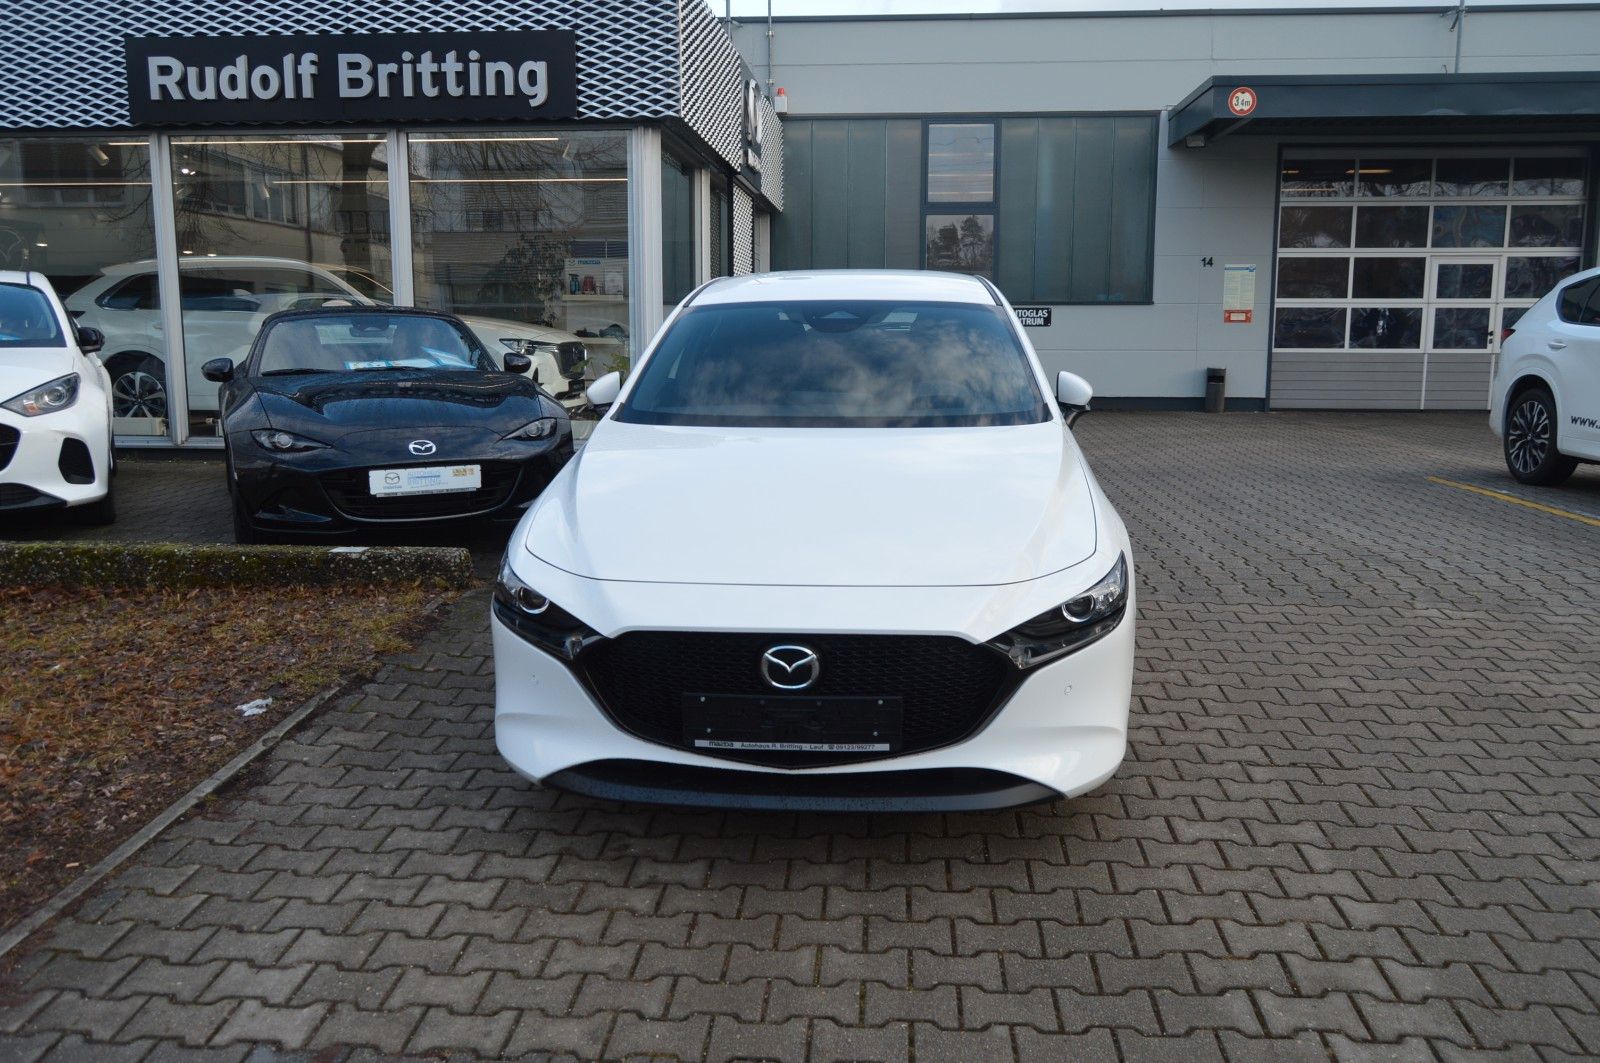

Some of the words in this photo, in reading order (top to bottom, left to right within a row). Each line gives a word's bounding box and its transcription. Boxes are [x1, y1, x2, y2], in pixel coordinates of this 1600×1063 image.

[147, 52, 319, 101] Rudolf
[337, 49, 549, 108] Britting
[1201, 256, 1214, 267] 14
[1020, 317, 1044, 326] TRUM
[709, 740, 734, 748] mazda
